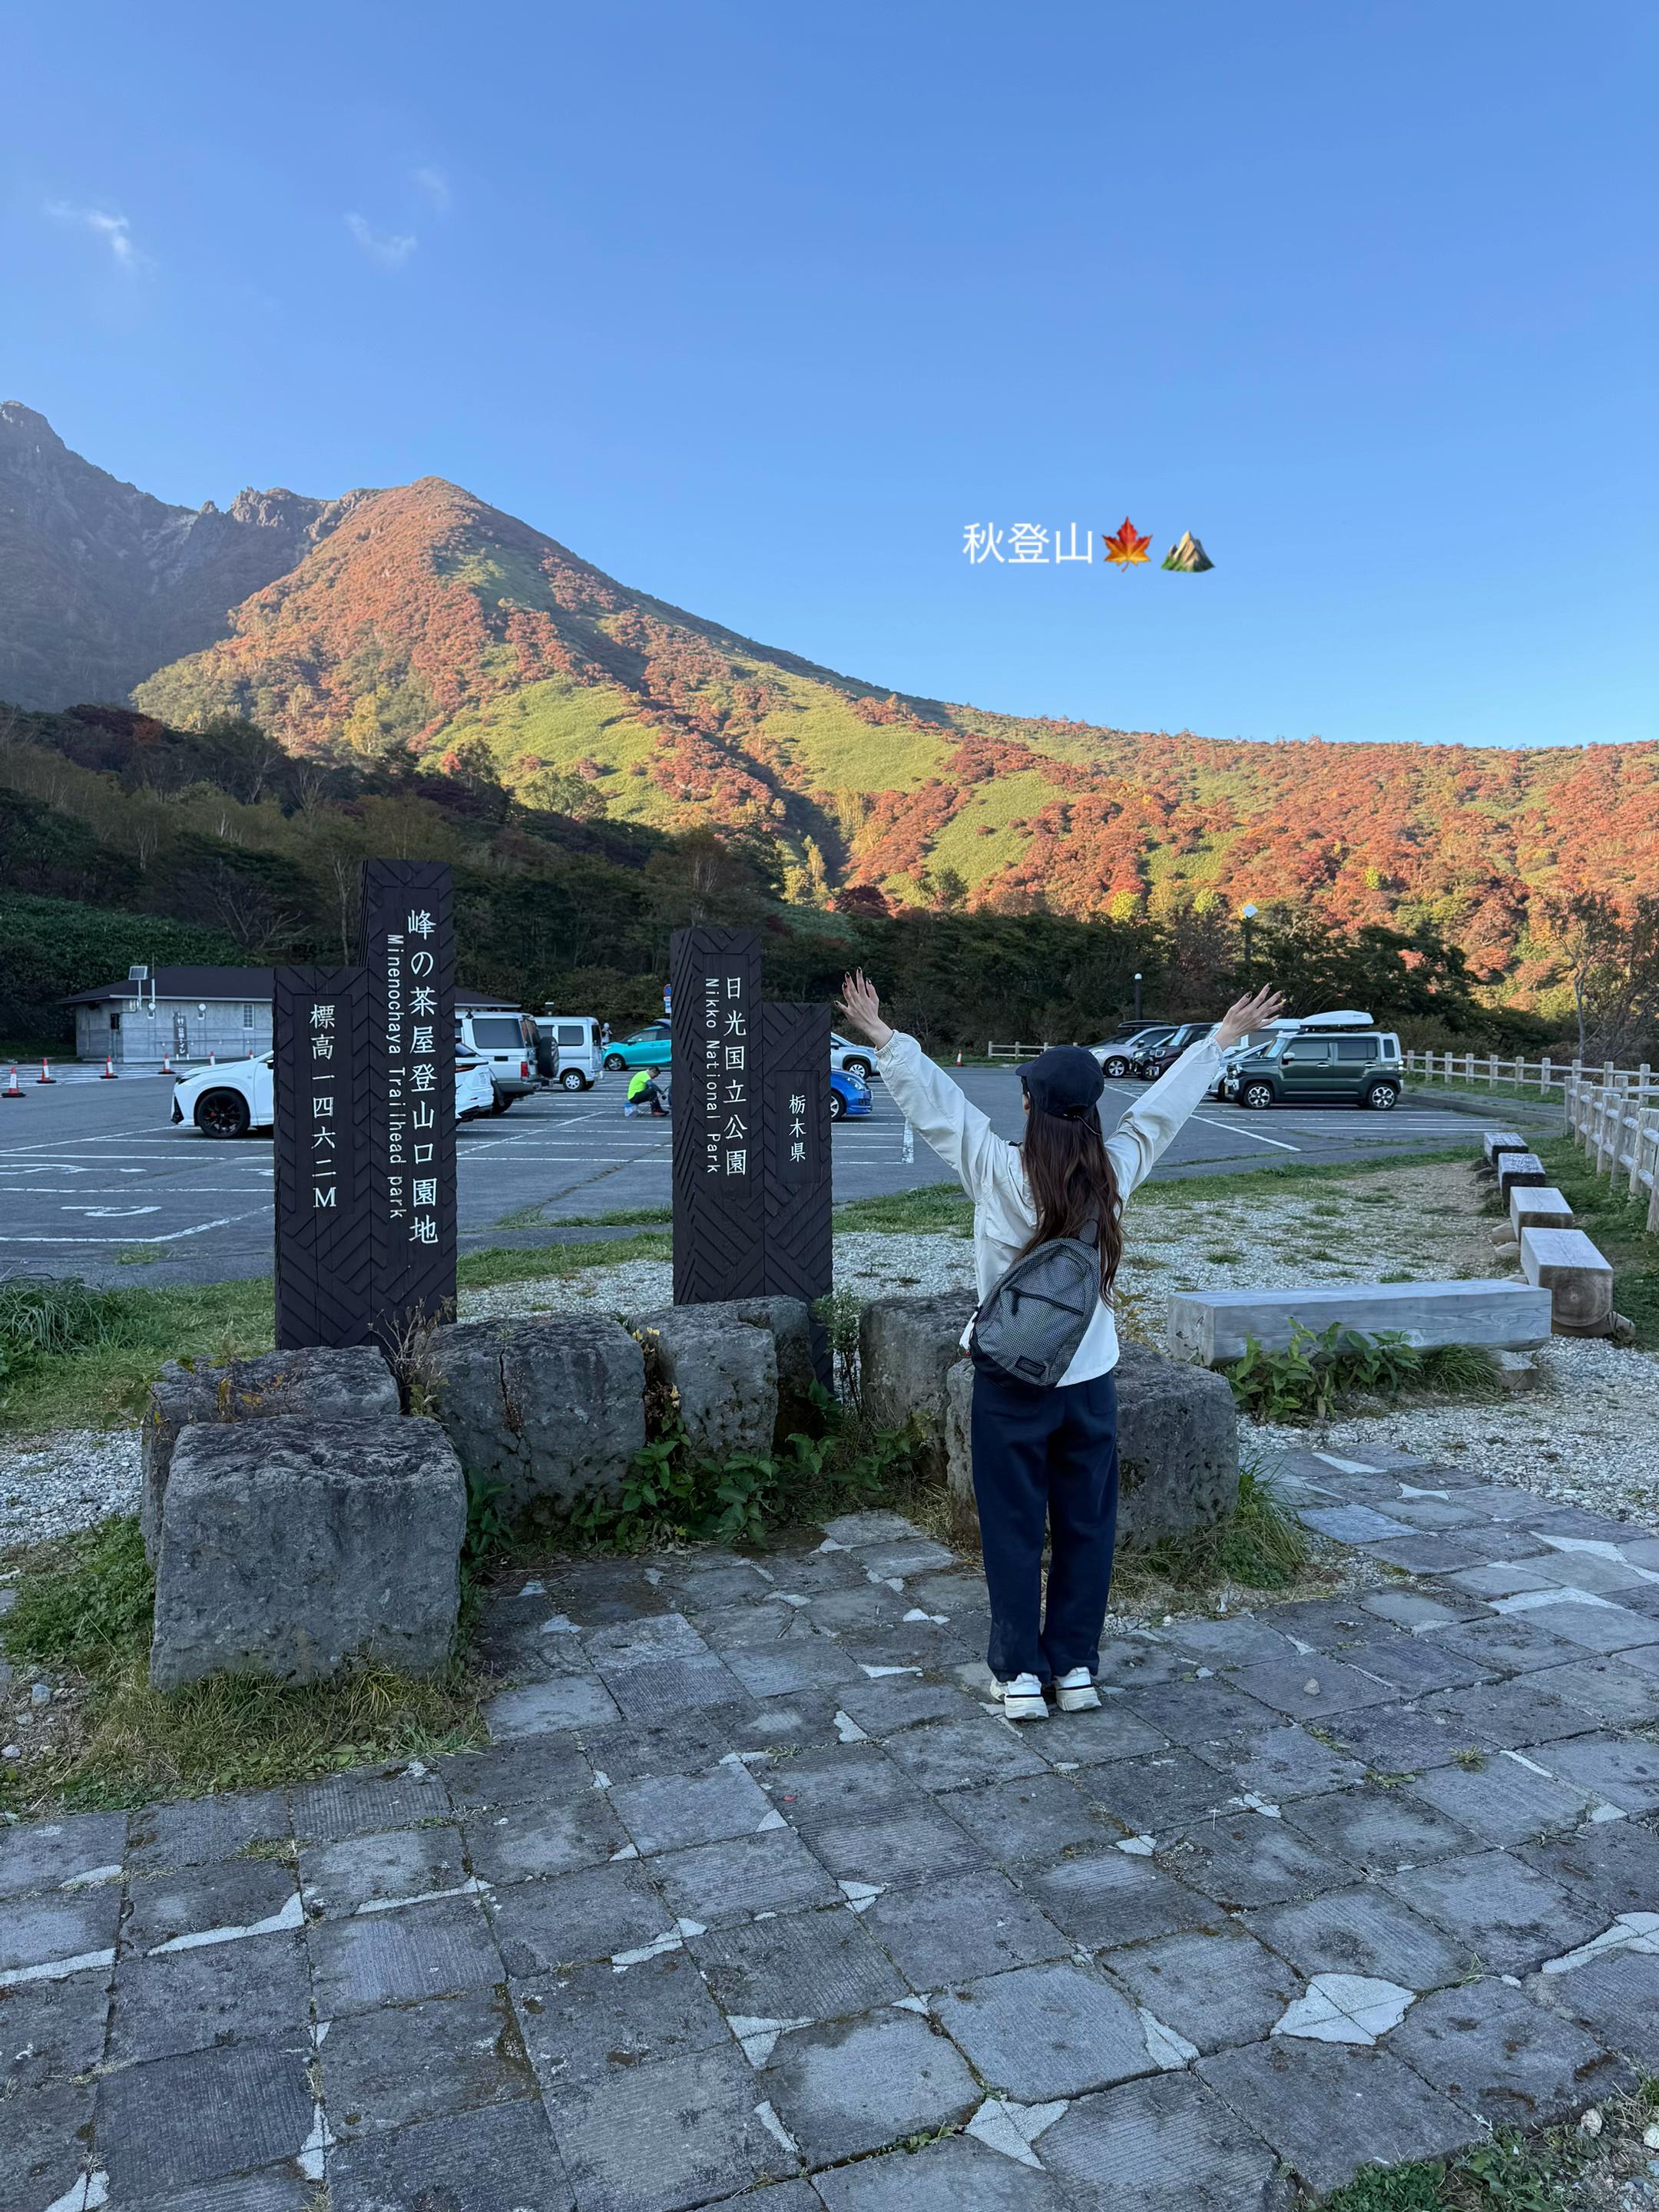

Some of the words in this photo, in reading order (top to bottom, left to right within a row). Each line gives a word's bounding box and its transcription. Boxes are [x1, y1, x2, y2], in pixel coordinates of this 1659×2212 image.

[386, 934, 406, 1054] Minenochaya
[704, 978, 720, 1028] Nikko
[309, 1003, 338, 1209] 標高一四六二M
[389, 1066, 408, 1164] Trailhead
[406, 909, 439, 1245] 峰の茶屋登山口園地
[705, 1039, 721, 1119] National
[723, 976, 748, 1177] 日光国立公園
[706, 1133, 722, 1174] Park
[788, 1093, 807, 1163] 栃木県
[386, 1176, 408, 1220] park
